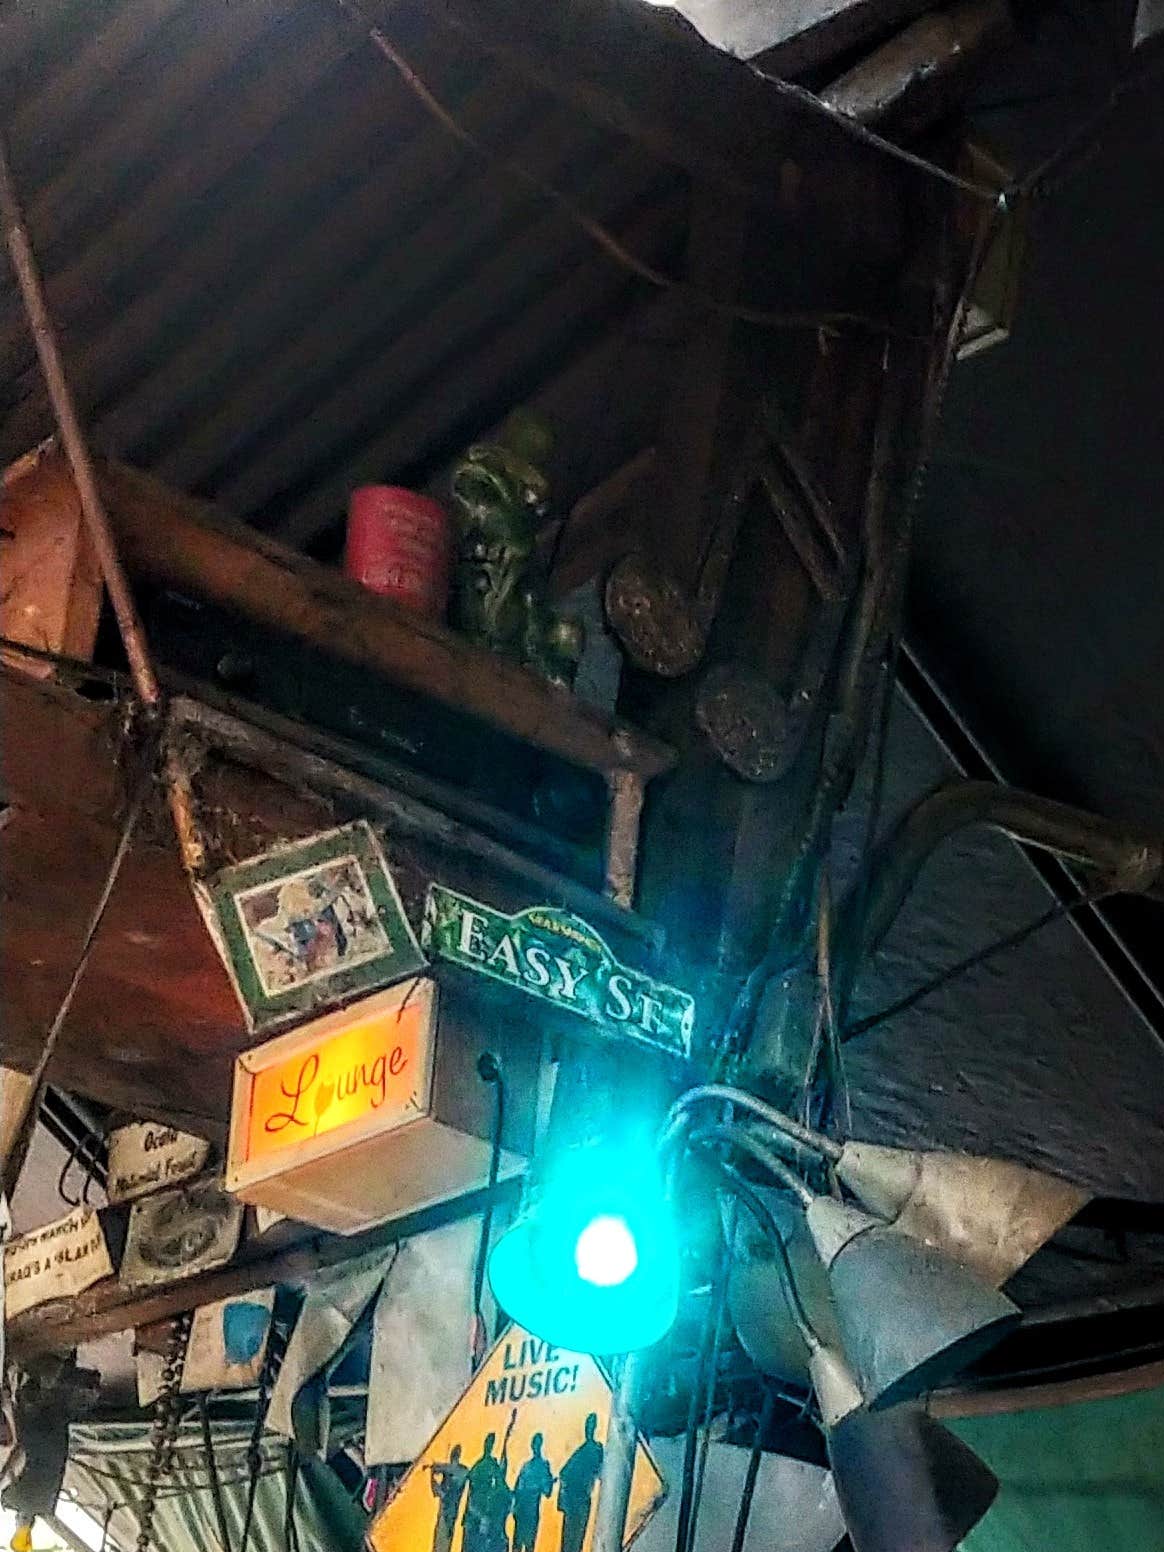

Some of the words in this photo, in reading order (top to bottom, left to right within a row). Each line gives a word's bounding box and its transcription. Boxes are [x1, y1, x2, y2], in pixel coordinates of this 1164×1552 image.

[458, 910, 588, 1000] EASY
[265, 1046, 408, 1136] Lounge
[484, 1364, 579, 1407] MUSIC!
[503, 1338, 559, 1370] LIVE
